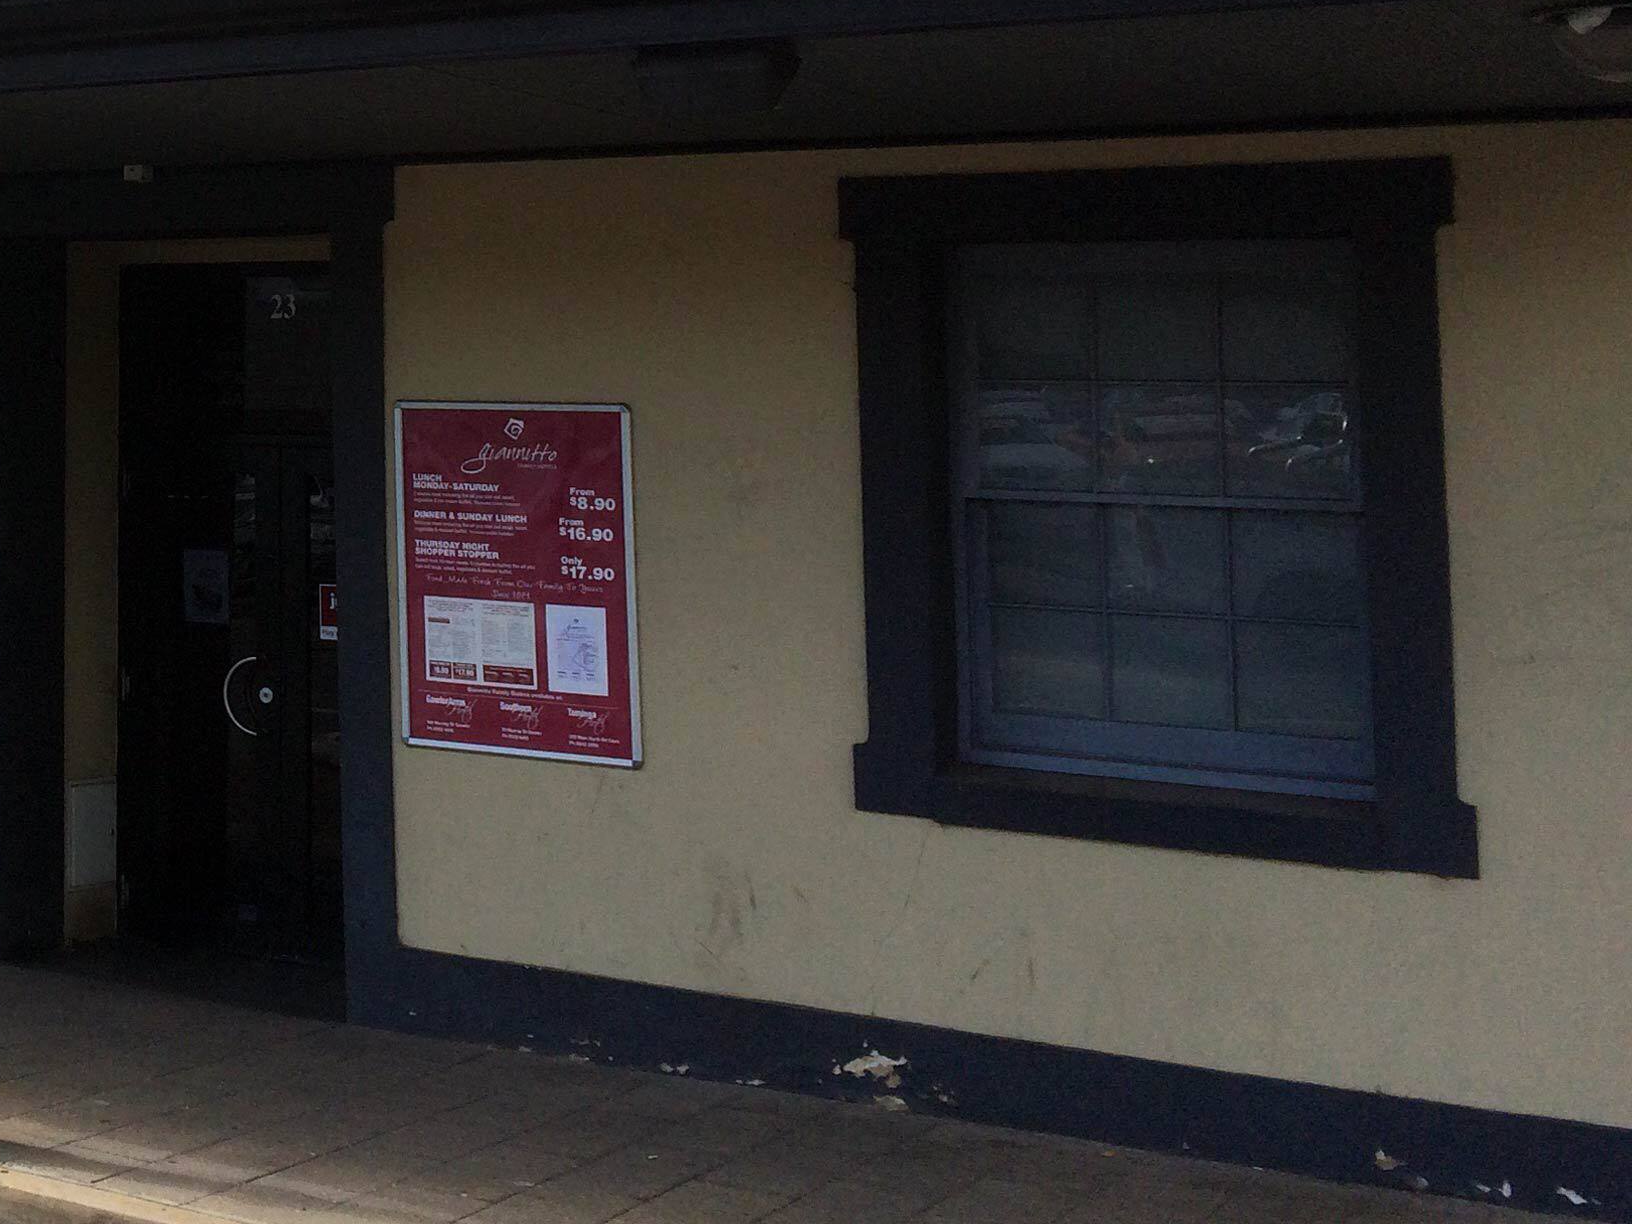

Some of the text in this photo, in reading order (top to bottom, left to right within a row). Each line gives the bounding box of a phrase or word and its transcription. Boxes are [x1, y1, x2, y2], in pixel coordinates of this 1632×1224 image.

[270, 294, 296, 319] 23
[412, 473, 443, 482] LUNCH
[569, 487, 595, 497] From
[569, 496, 616, 511] $8.90
[414, 510, 528, 524] DINNER & SUNDAY LUNCH
[558, 517, 584, 526] From
[559, 526, 614, 542] $16.90
[414, 539, 490, 551] THURSDAY NIGHT
[414, 548, 500, 560] SHOPPER STOPPER
[560, 556, 583, 566] Only
[561, 565, 615, 581] $17.90
